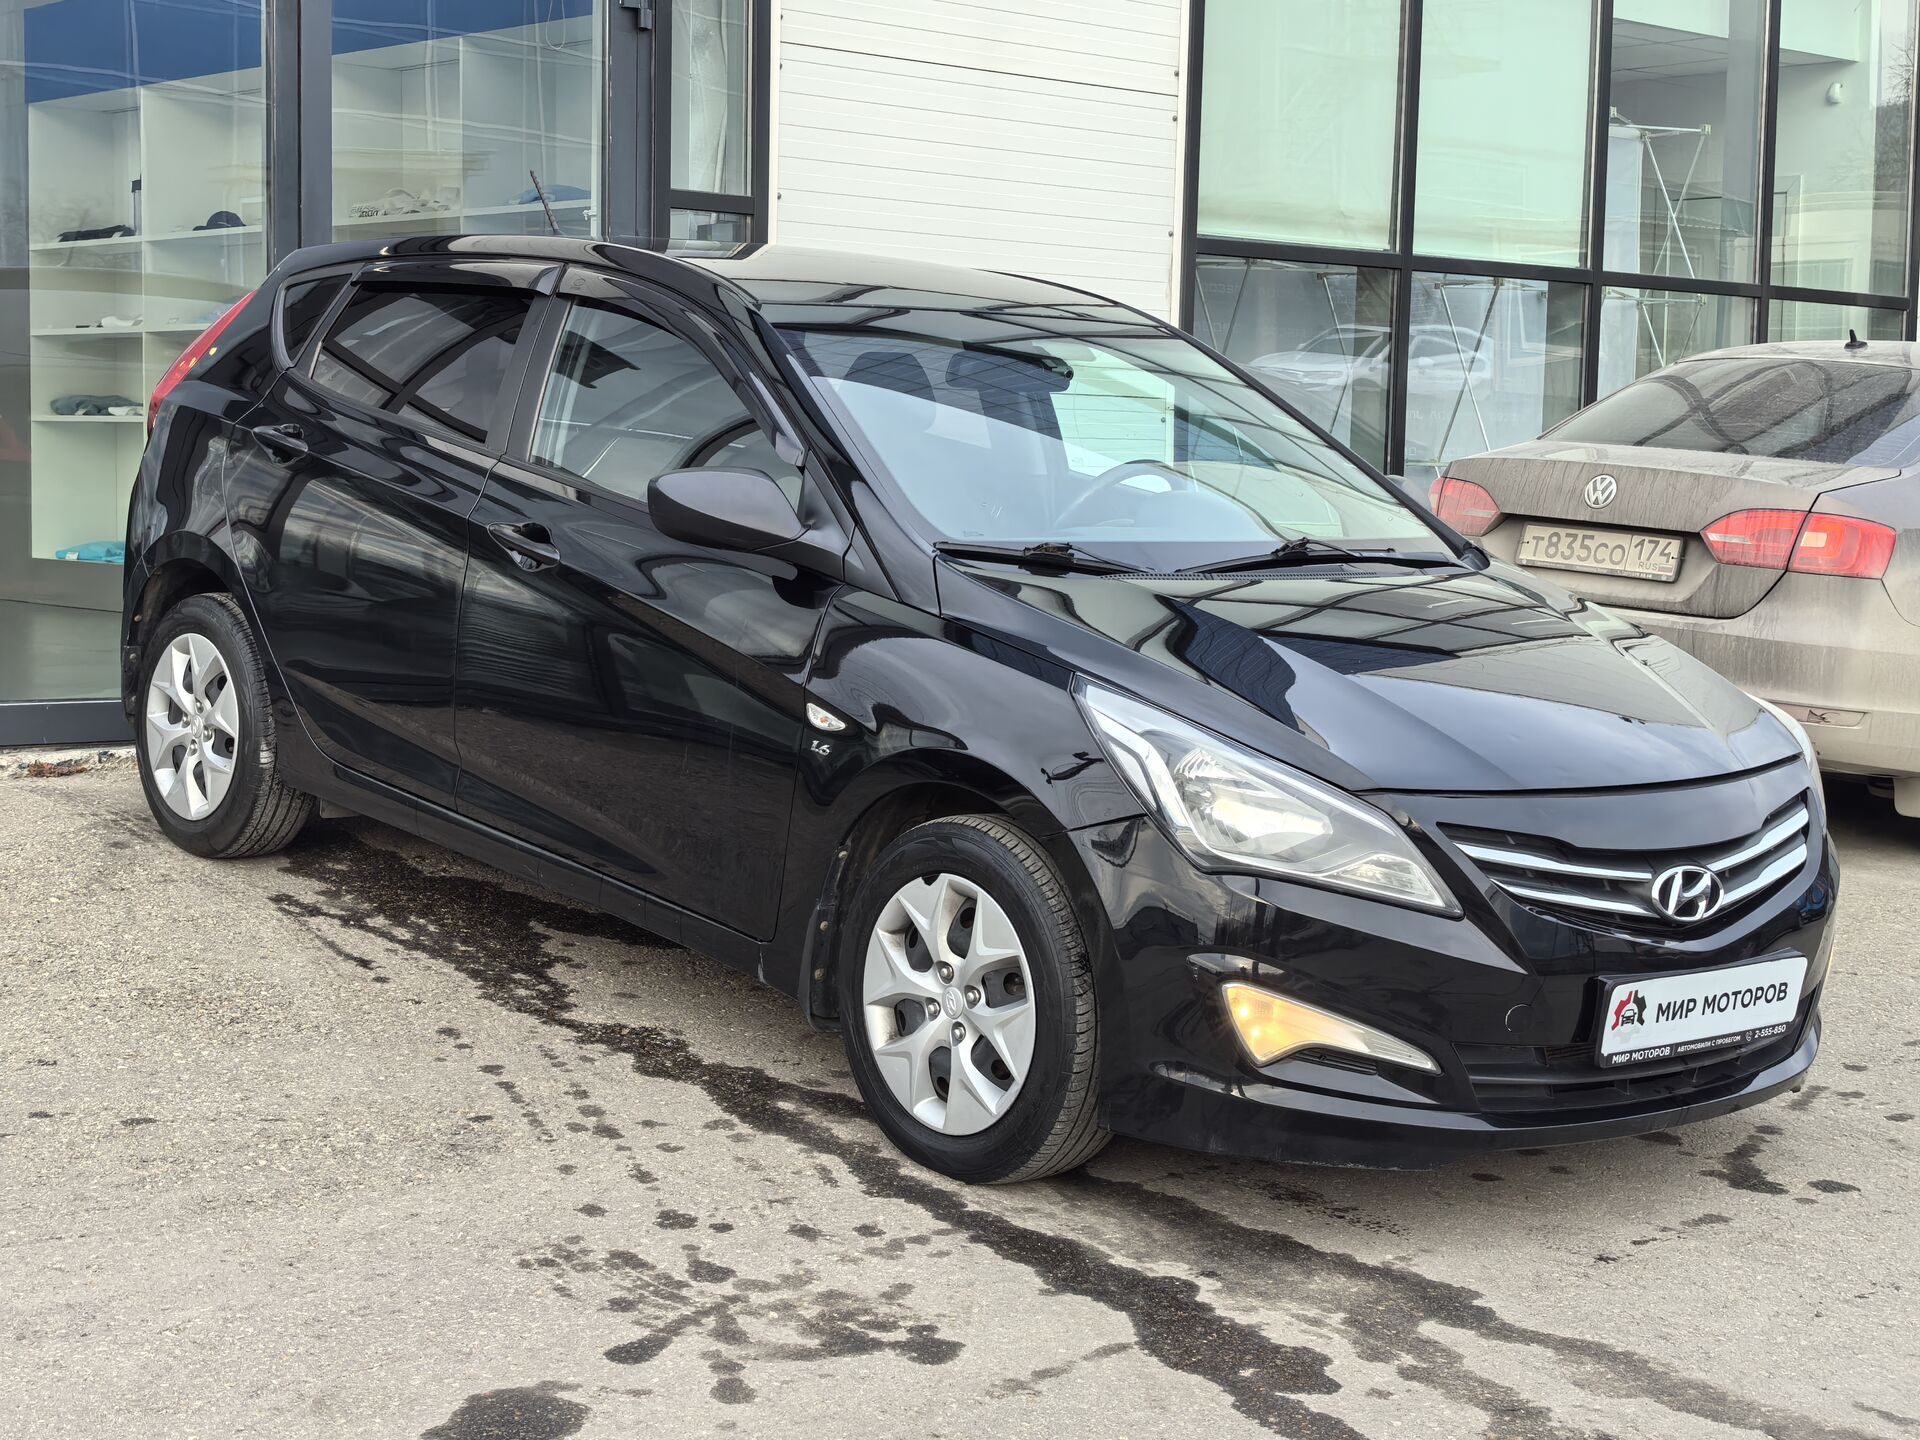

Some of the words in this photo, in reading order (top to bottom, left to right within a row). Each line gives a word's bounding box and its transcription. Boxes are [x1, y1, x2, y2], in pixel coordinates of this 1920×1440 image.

[1634, 538, 1672, 563] 174
[1638, 561, 1659, 571] RUS
[1656, 998, 1697, 1023] МИР
[1702, 982, 1788, 1016] МОТОРОВ
[1677, 1041, 1711, 1052] АВТОМОБИЛИ
[1715, 1034, 1741, 1046] ПРОБЕГОМ
[1612, 1053, 1630, 1064] МИР
[1631, 1046, 1671, 1061] МОТОРОВ
